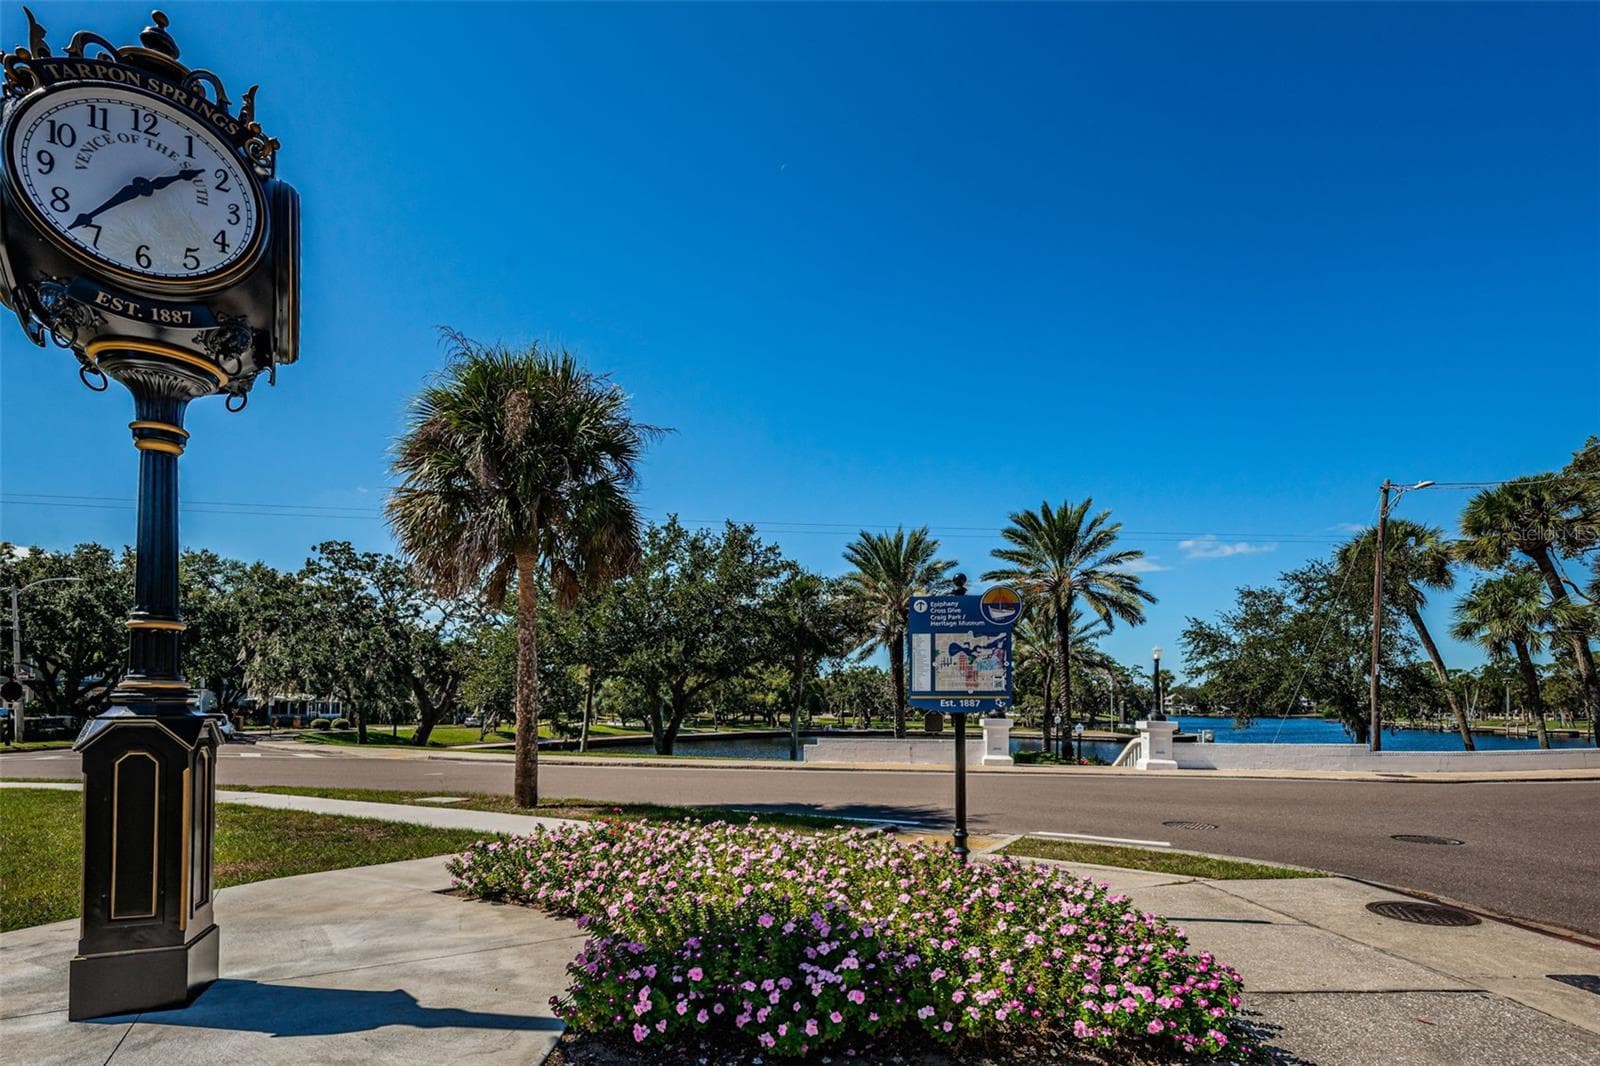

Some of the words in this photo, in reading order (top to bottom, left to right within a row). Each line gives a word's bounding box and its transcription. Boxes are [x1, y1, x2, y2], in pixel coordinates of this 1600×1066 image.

[43, 64, 141, 87] TARPON
[148, 78, 239, 136] SPRINGS
[87, 104, 111, 133] 11
[130, 109, 161, 138] 12
[47, 119, 77, 149] 10
[184, 135, 196, 160] 1
[37, 149, 55, 175] 9
[75, 133, 116, 170] VENICE
[117, 132, 140, 145] OF
[143, 137, 180, 162] THE
[179, 161, 209, 207] SUTH
[214, 169, 230, 192] 2
[50, 186, 70, 213] 8
[227, 203, 240, 225] 3
[82, 223, 102, 251] 7
[213, 230, 230, 253] 4
[135, 244, 152, 269] 6
[183, 247, 200, 271] 5
[96, 291, 144, 318] EST.
[150, 306, 193, 325] 1887
[940, 699, 957, 708] Est.
[959, 699, 981, 708] 1887
